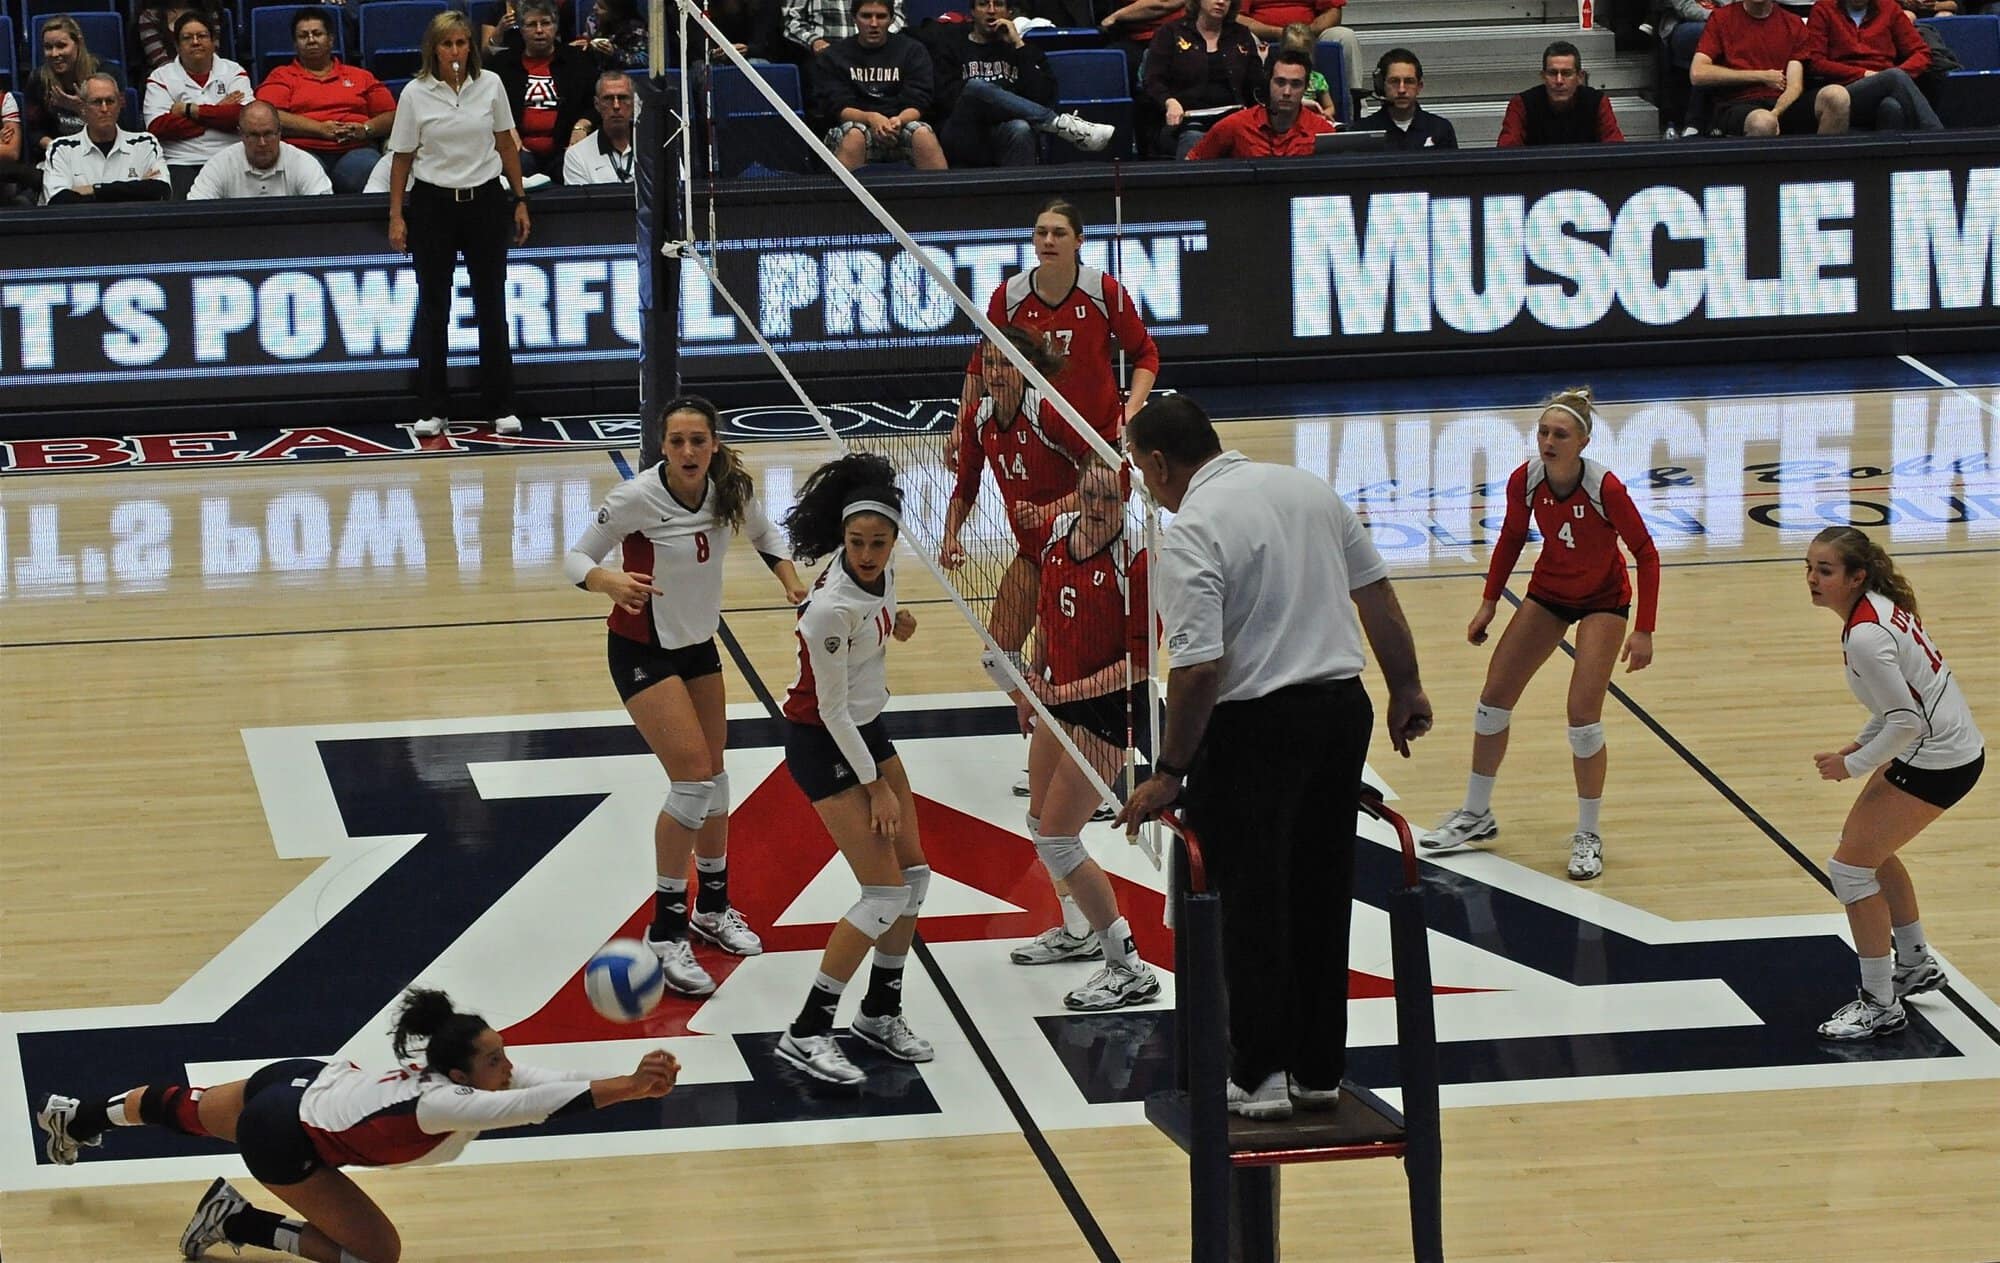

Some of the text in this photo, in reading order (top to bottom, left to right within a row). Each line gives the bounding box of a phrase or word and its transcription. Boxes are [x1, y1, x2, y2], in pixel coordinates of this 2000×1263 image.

[849, 66, 900, 82] ARIZONA
[1291, 181, 1857, 337] MUSCLE
[0, 277, 168, 369] T'S
[1074, 305, 1087, 319] U
[1042, 329, 1073, 356] 17
[1, 419, 600, 471] BEAR
[1016, 430, 1028, 444] U
[998, 452, 1030, 481] 14
[1572, 504, 1585, 519] U
[694, 531, 710, 563] 8
[1558, 521, 1576, 549] 4
[1092, 570, 1106, 586] U
[1059, 585, 1077, 618] 6
[1910, 627, 1943, 674] 1
